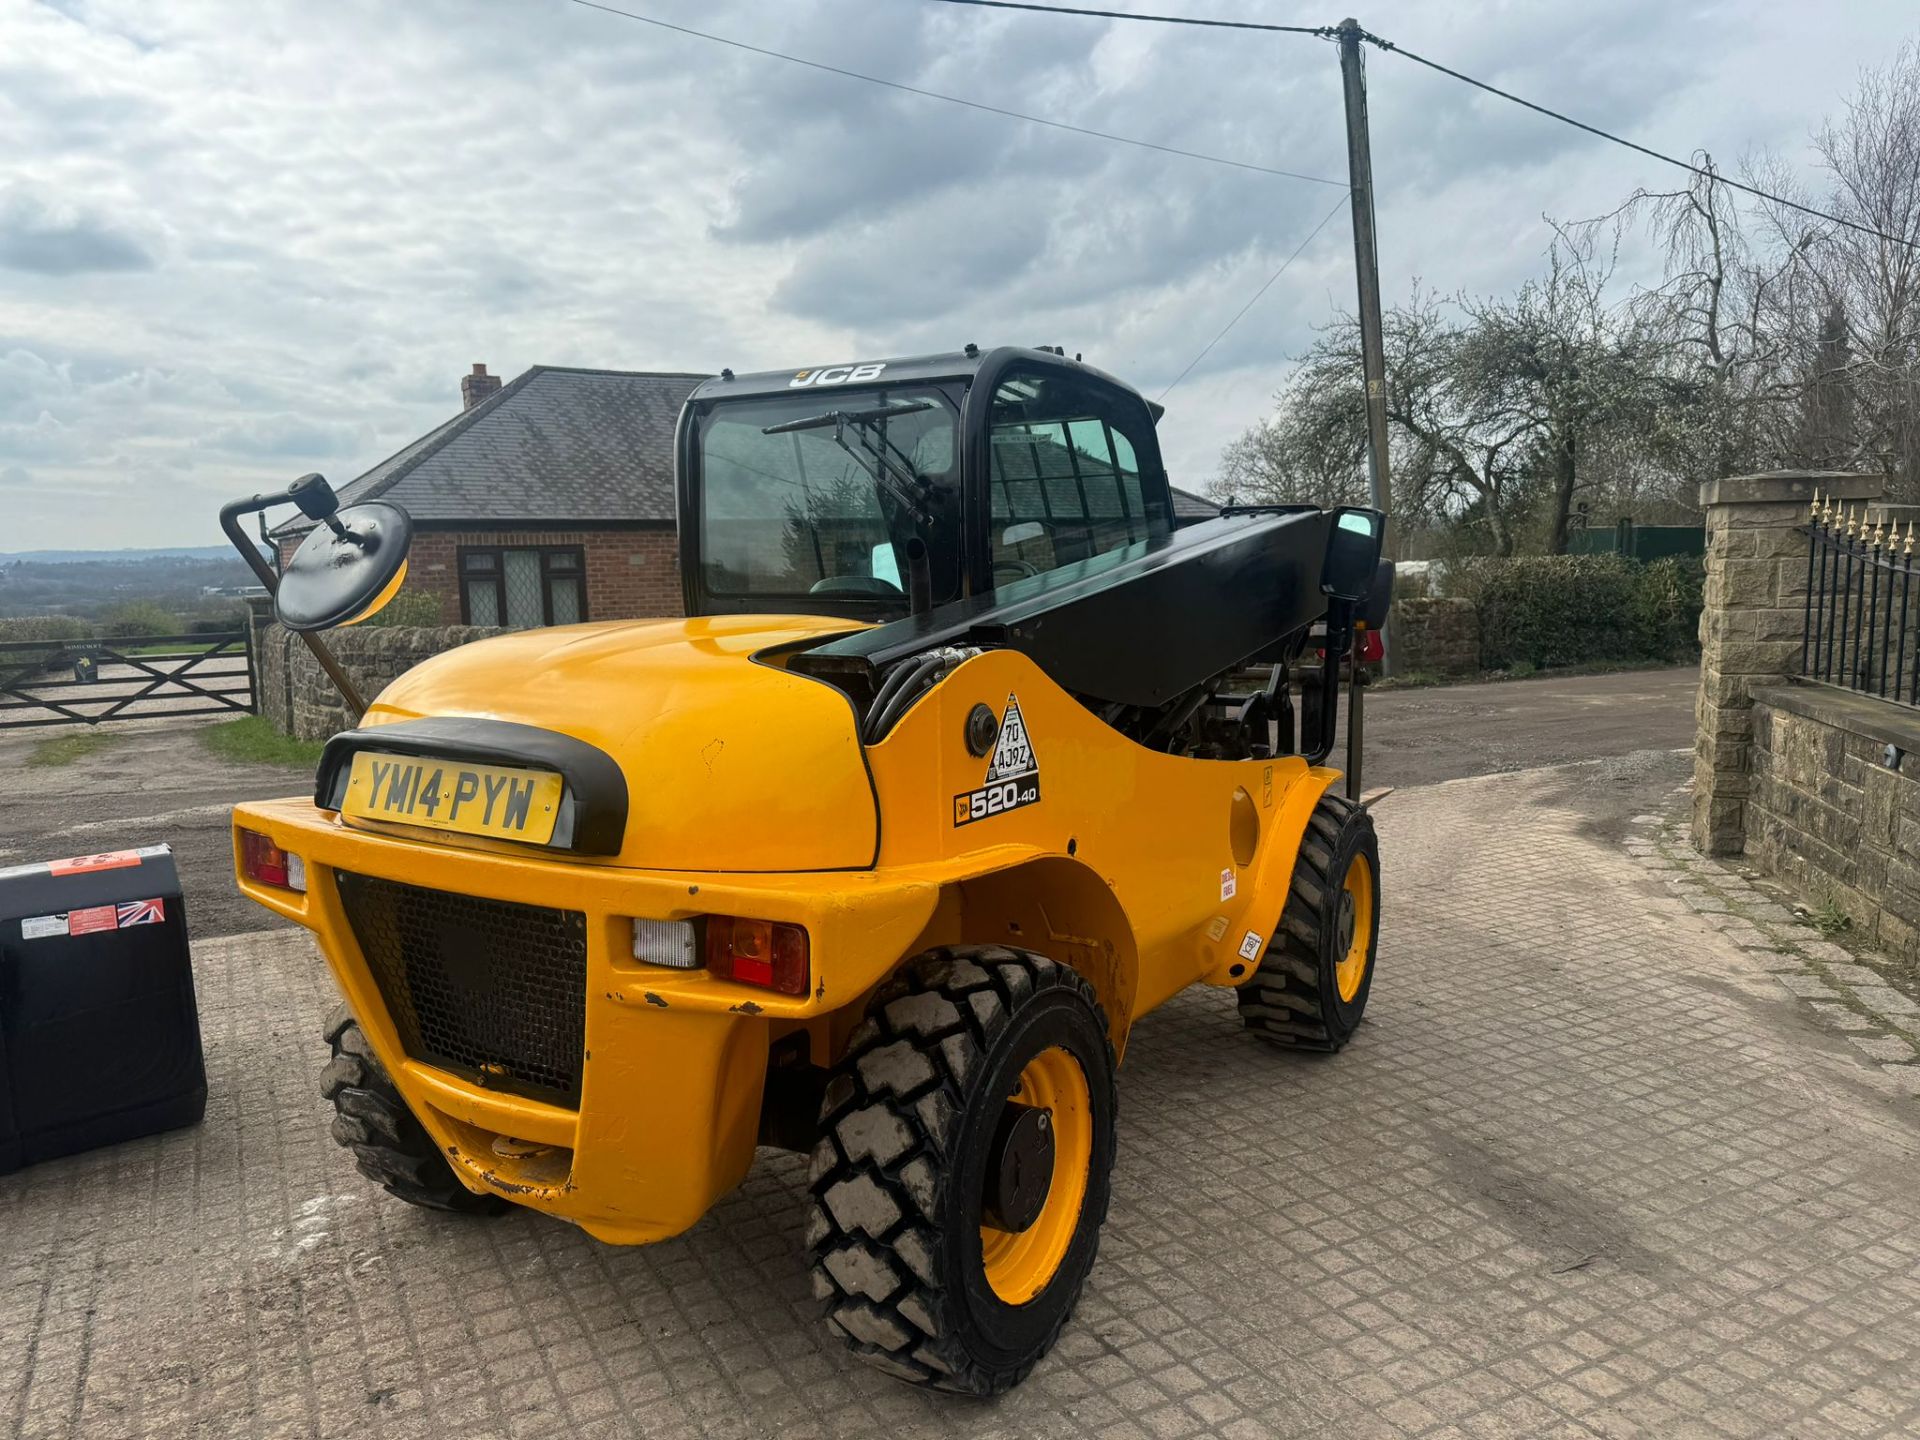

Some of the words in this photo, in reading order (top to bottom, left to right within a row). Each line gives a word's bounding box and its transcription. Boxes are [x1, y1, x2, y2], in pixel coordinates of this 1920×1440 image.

[789, 363, 887, 388] JCB
[998, 745, 1026, 769] AJ9Z
[368, 761, 444, 818] YM14
[449, 771, 535, 831] PYW
